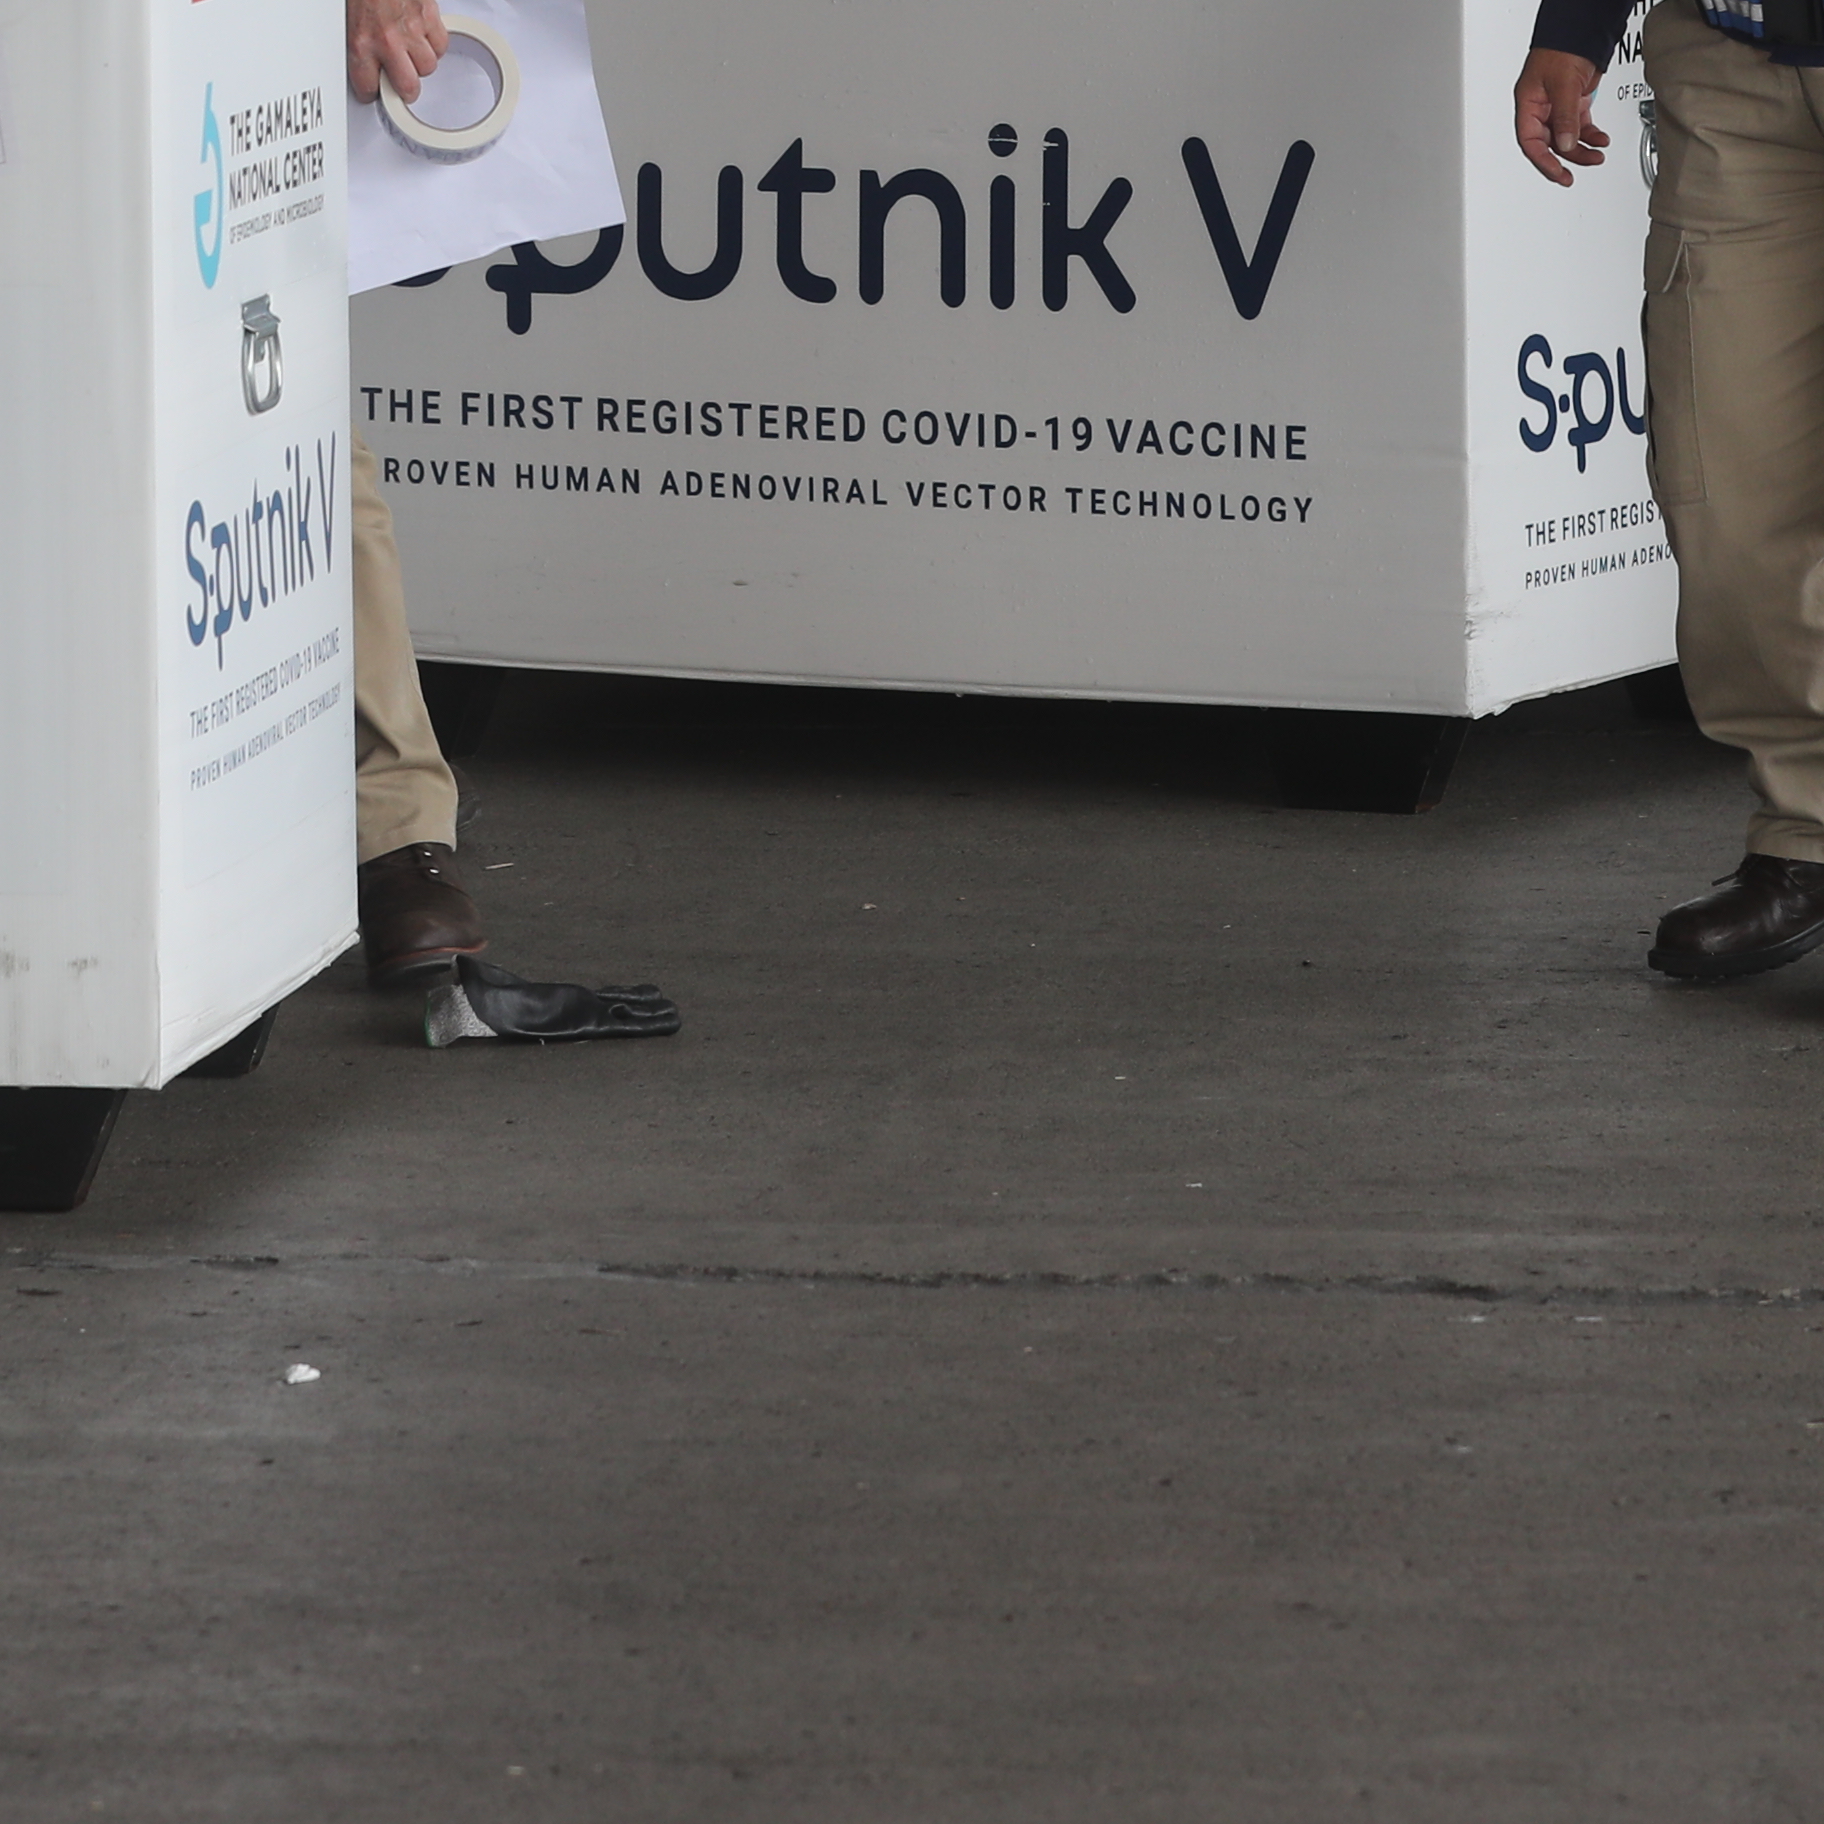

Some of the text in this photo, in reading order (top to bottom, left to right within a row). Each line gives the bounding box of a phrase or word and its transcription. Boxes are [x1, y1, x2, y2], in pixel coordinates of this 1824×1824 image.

[230, 109, 251, 155] THE
[256, 86, 322, 147] GAMALEYA
[230, 141, 323, 210] NATIONAL CENTER
[1181, 137, 1315, 320] V
[360, 387, 1306, 460] THE FIRST REGISTERED COVID-19 VACCINE
[317, 431, 336, 574] V
[384, 458, 1312, 523] ROVEN HUMAN ADENOVIRAL VECTOR TECHNOLOGY
[1525, 510, 1606, 547] THE FIRST
[1526, 552, 1625, 589] PROVEN HUMAN
